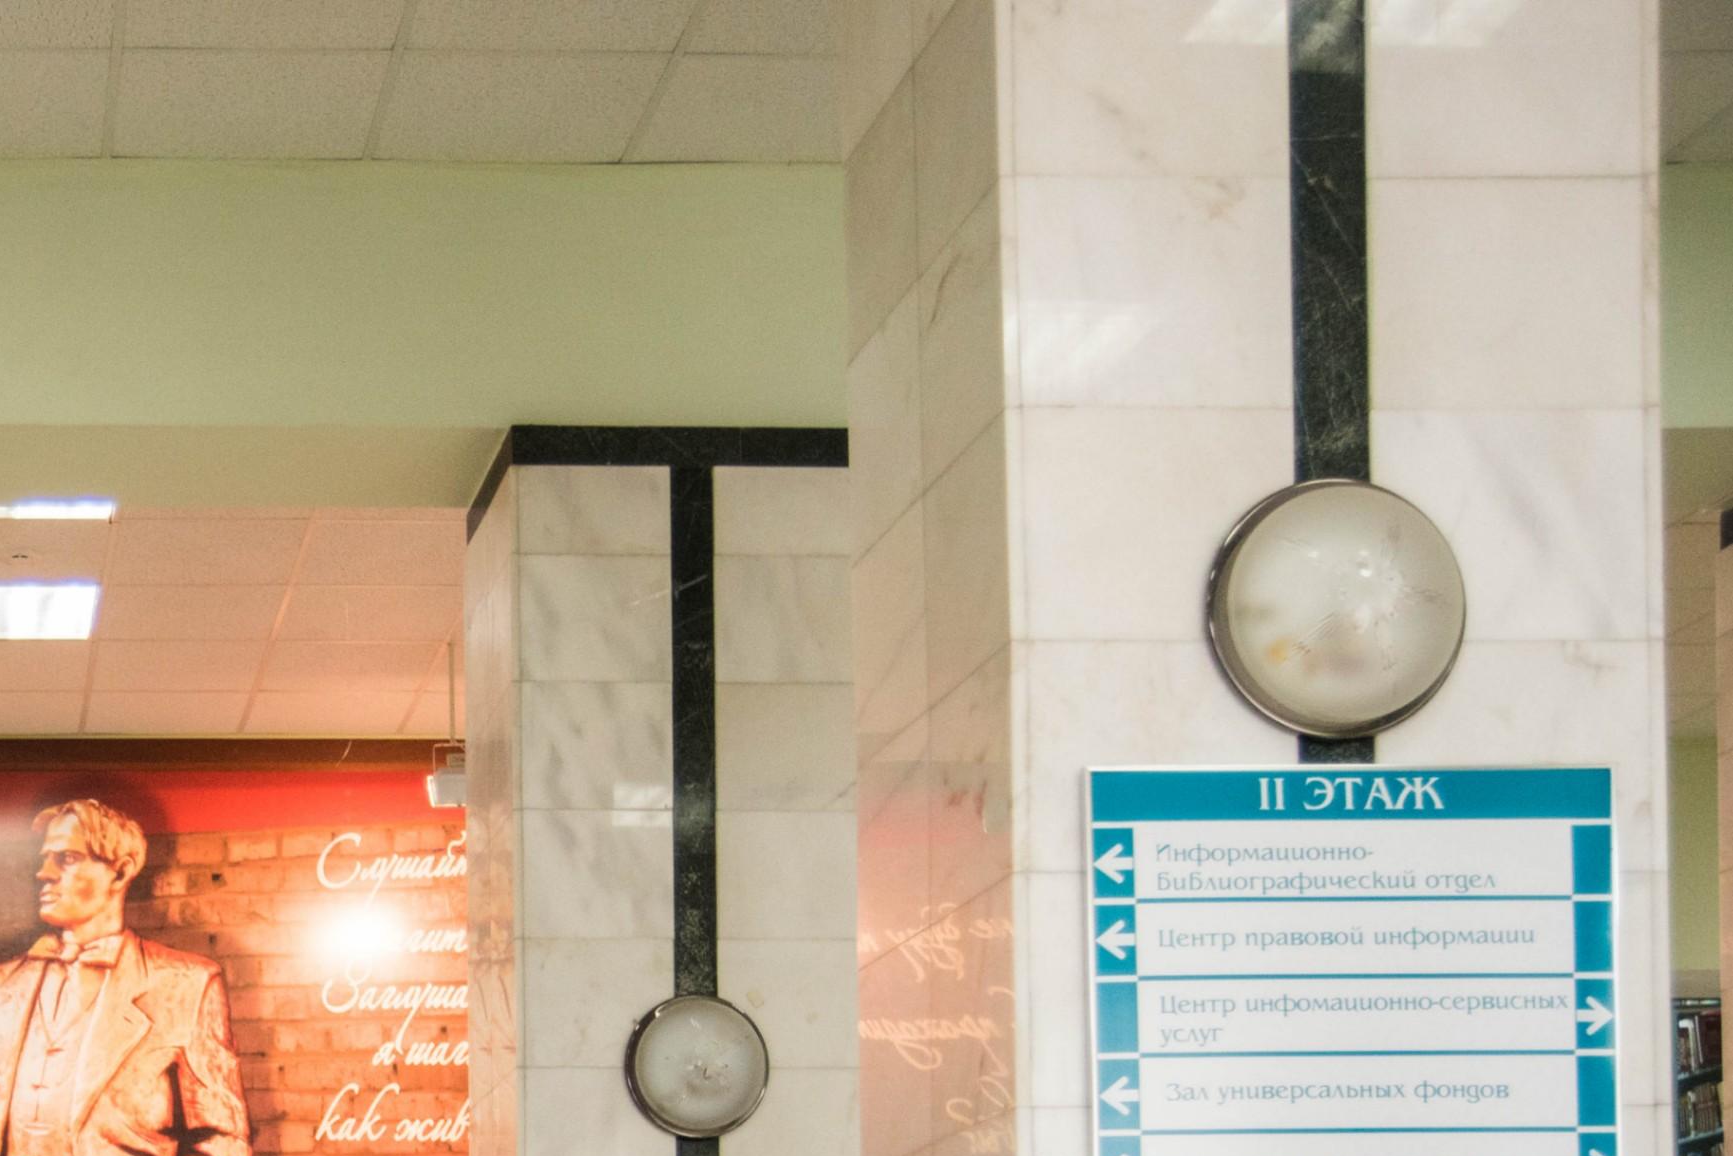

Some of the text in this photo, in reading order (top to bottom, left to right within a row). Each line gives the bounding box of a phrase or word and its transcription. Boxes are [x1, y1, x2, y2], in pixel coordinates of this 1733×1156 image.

[1303, 776, 1445, 811] ЭТАЖ
[1157, 871, 1497, 893] библиографический отдел
[1158, 926, 1535, 950] Центр правовой информации
[1160, 996, 1237, 1017] Центр
[1160, 1026, 1224, 1048] услуг
[1166, 1081, 1510, 1105] Зал универсальных фондов
[315, 1083, 401, 1142] как
